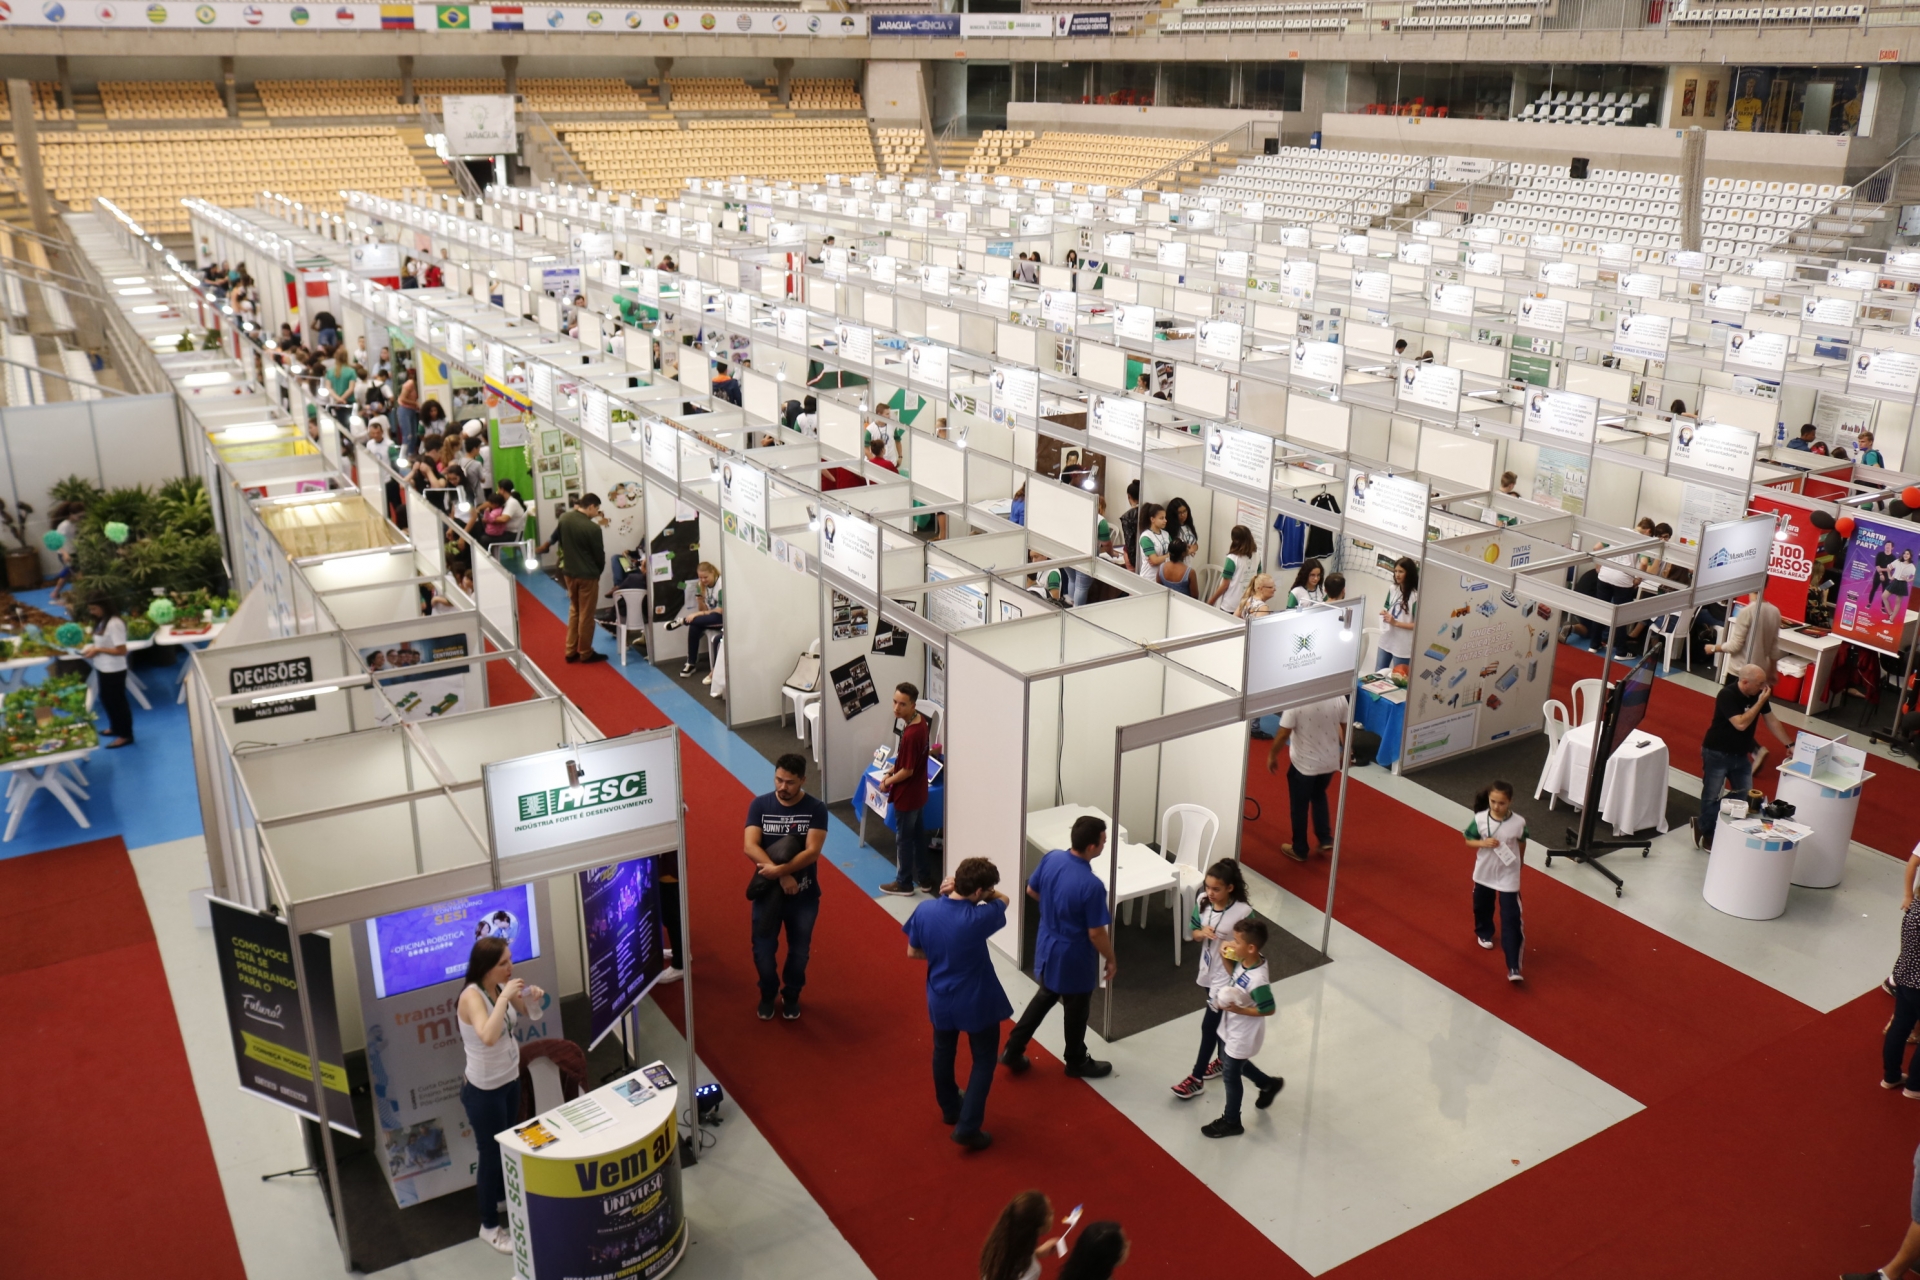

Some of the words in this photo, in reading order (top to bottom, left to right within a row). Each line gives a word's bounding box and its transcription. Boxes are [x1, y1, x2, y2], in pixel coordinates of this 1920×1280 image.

[916, 20, 947, 30] CIÊNCIA
[1706, 462, 1725, 470] Londrina
[1382, 518, 1399, 529] Lontras
[1855, 540, 1879, 551] PARTY
[1857, 535, 1884, 547] CAMPUS
[1513, 544, 1532, 554] TINTAS
[1744, 547, 1757, 557] WEG
[1779, 545, 1802, 560] 100
[1788, 568, 1806, 579] ÁREAS
[432, 649, 465, 660] CENTROWEG
[1289, 651, 1316, 663] FUJAMA
[233, 661, 307, 688] DECISÕES
[255, 708, 272, 718] MAIS
[273, 704, 296, 715] AINDA
[514, 819, 554, 832] INDÚSTRIA
[555, 813, 578, 824] FORTE
[579, 811, 584, 819] É
[585, 797, 654, 818] DESENVOLVIMENTO
[763, 823, 790, 834] BUNNY'S
[434, 899, 484, 915] CONTRATURNO
[434, 909, 468, 926] SESI
[393, 940, 426, 954] OFICINA
[426, 930, 466, 947] ROBÓTICA
[231, 937, 261, 954] COMO
[261, 947, 289, 963] VOCÊ
[234, 948, 255, 962] ESTÁ
[257, 956, 269, 968] SE
[236, 960, 298, 991] PREPARANDO
[238, 973, 264, 988] PARA
[263, 982, 272, 993] O
[241, 994, 282, 1019] Futuro?
[433, 1037, 457, 1051] com
[418, 1083, 437, 1093] Curta
[419, 1090, 442, 1100] Ensino
[575, 1147, 649, 1192] Vem
[653, 1125, 671, 1165] aí
[504, 1152, 522, 1208] SESI
[621, 1255, 642, 1269] Saiba
